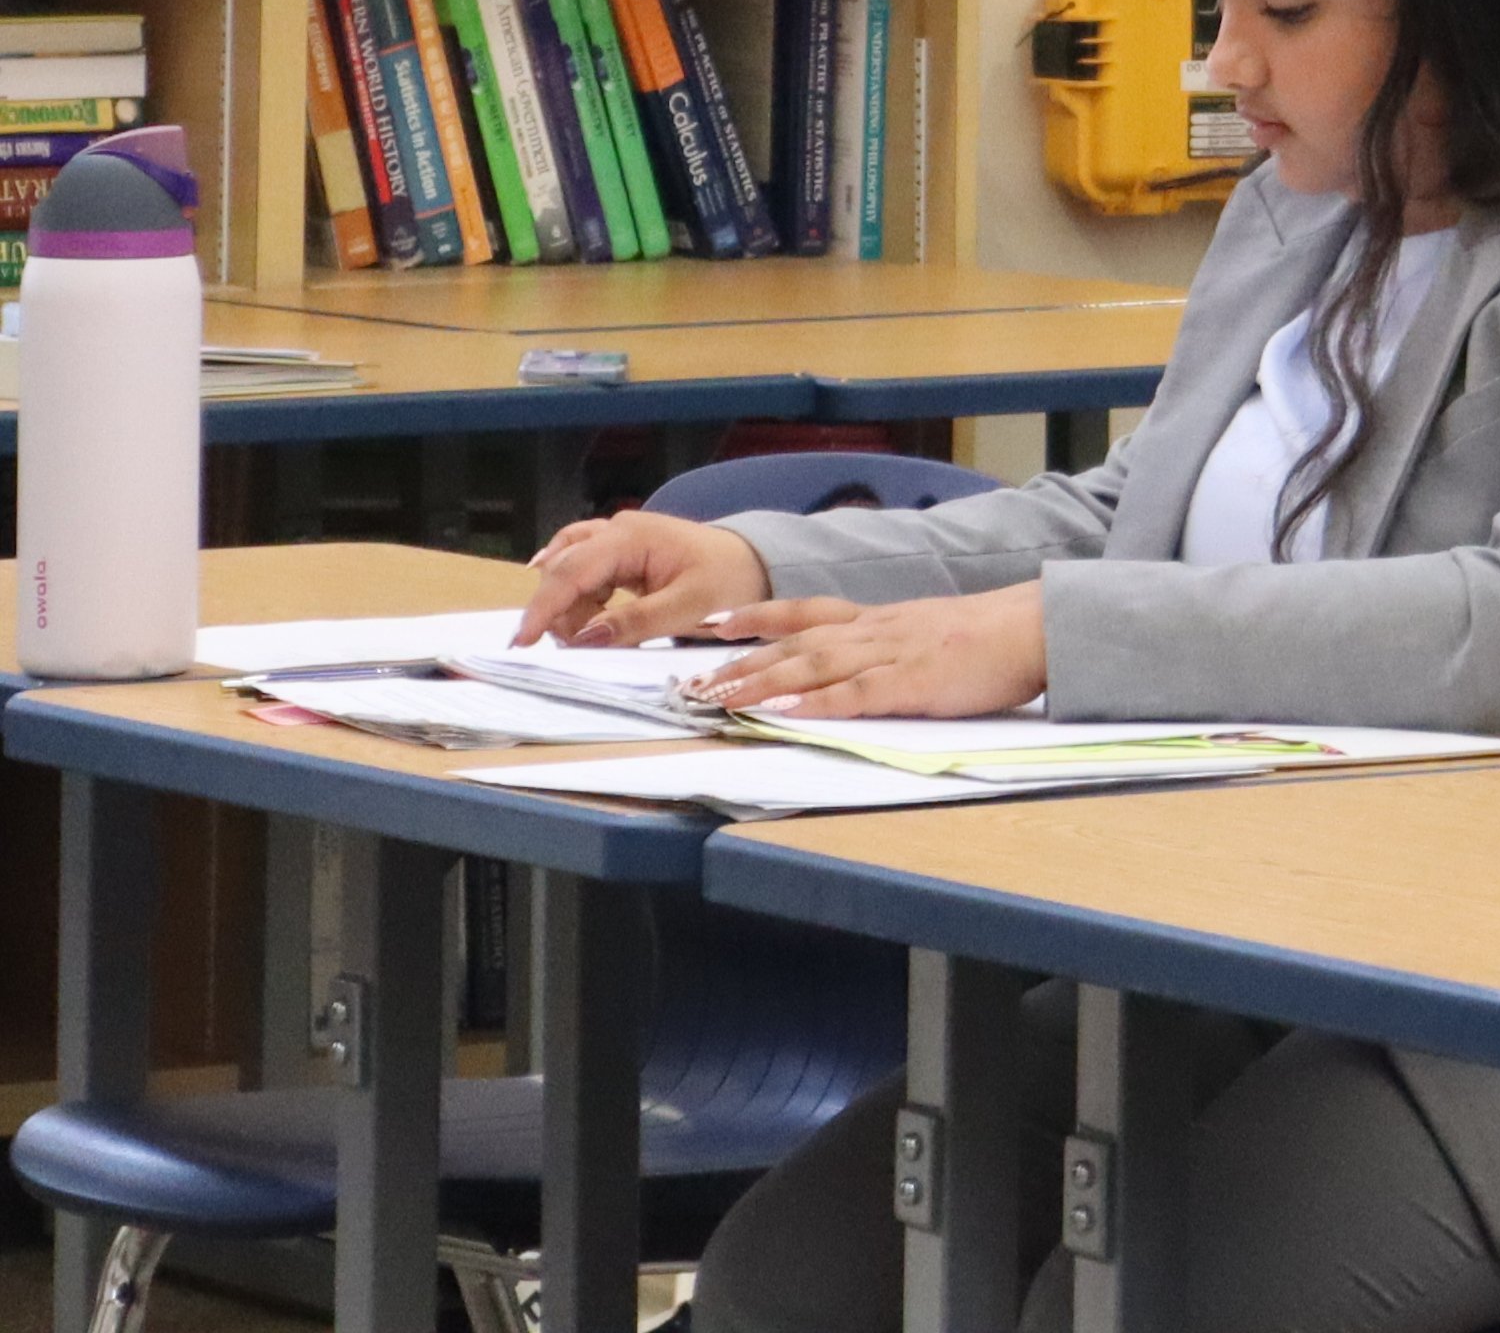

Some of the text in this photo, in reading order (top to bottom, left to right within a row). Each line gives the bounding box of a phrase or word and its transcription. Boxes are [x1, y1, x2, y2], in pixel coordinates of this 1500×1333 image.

[358, 37, 388, 111] WORLD
[376, 114, 407, 199] HISTORY
[495, 1, 552, 175] American Government
[691, 32, 724, 101] PRACTICE
[720, 121, 758, 202] STATISTICS
[816, 22, 827, 91] PRACTICE
[864, 21, 884, 222] UNDERSTANDING PHILOSOPHY
[392, 58, 441, 200] Statistics in Action
[663, 89, 717, 187] Calculus
[813, 119, 824, 201] STATISTICS
[33, 560, 48, 630] owala
